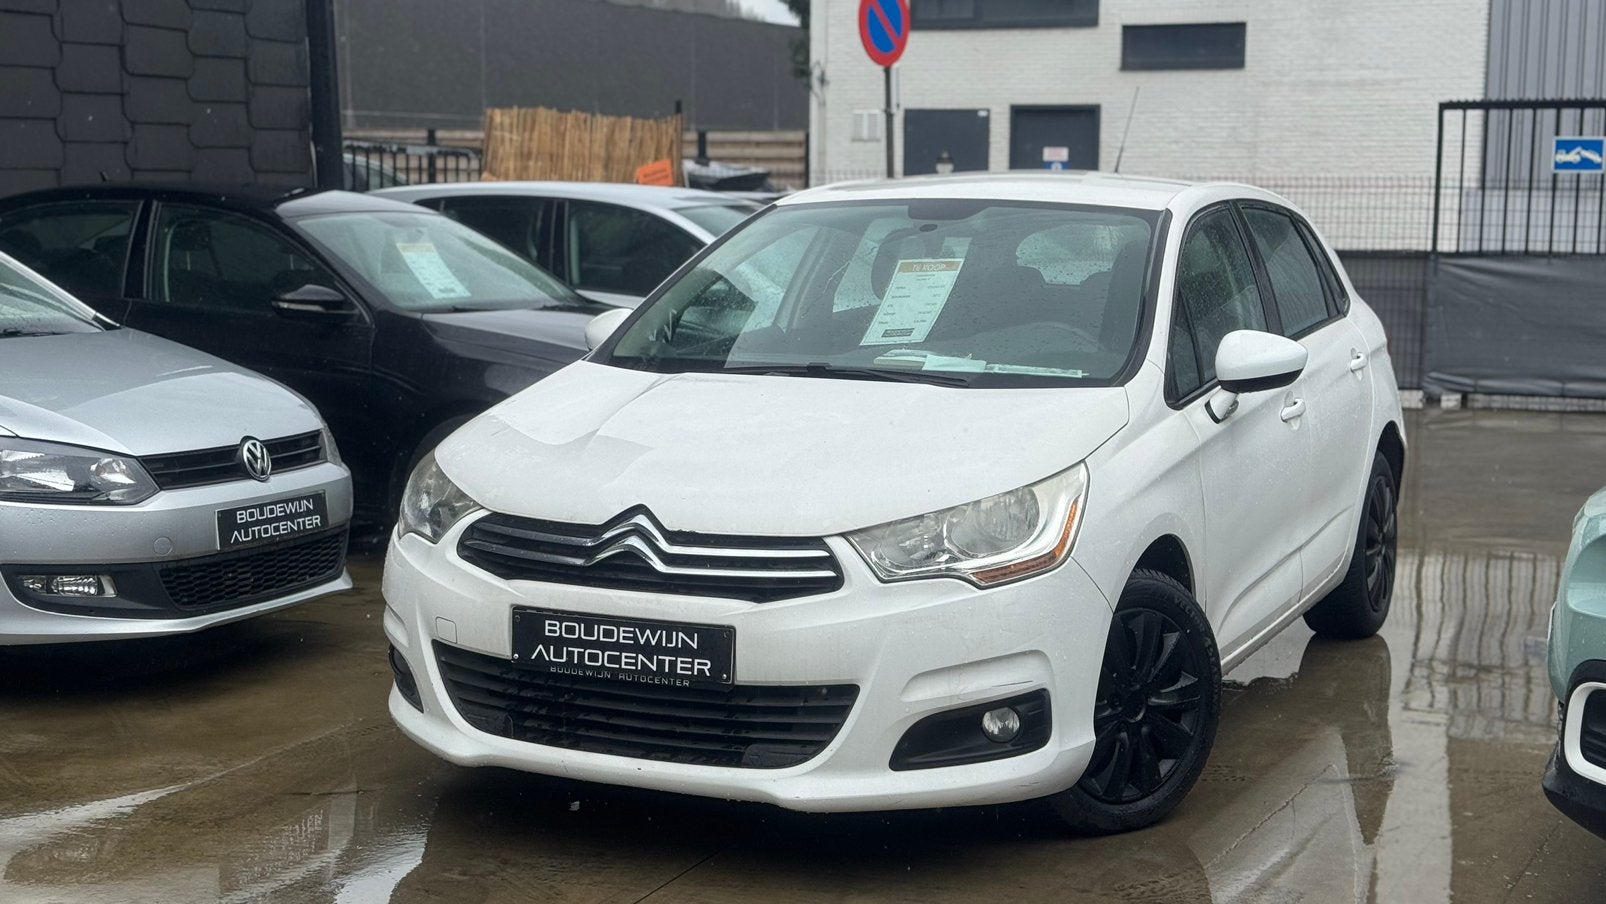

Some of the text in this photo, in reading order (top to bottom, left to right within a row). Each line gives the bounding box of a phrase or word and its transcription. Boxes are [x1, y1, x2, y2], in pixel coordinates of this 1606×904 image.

[922, 263, 946, 271] KOOP
[236, 498, 314, 524] BOUDEWIJN
[230, 515, 322, 544] AUTOCENTER
[544, 619, 698, 650] BOUDEWIJN
[531, 644, 712, 677] AUTOCENTER
[550, 666, 690, 687] BOUDEWIJN AUTOCENTER
